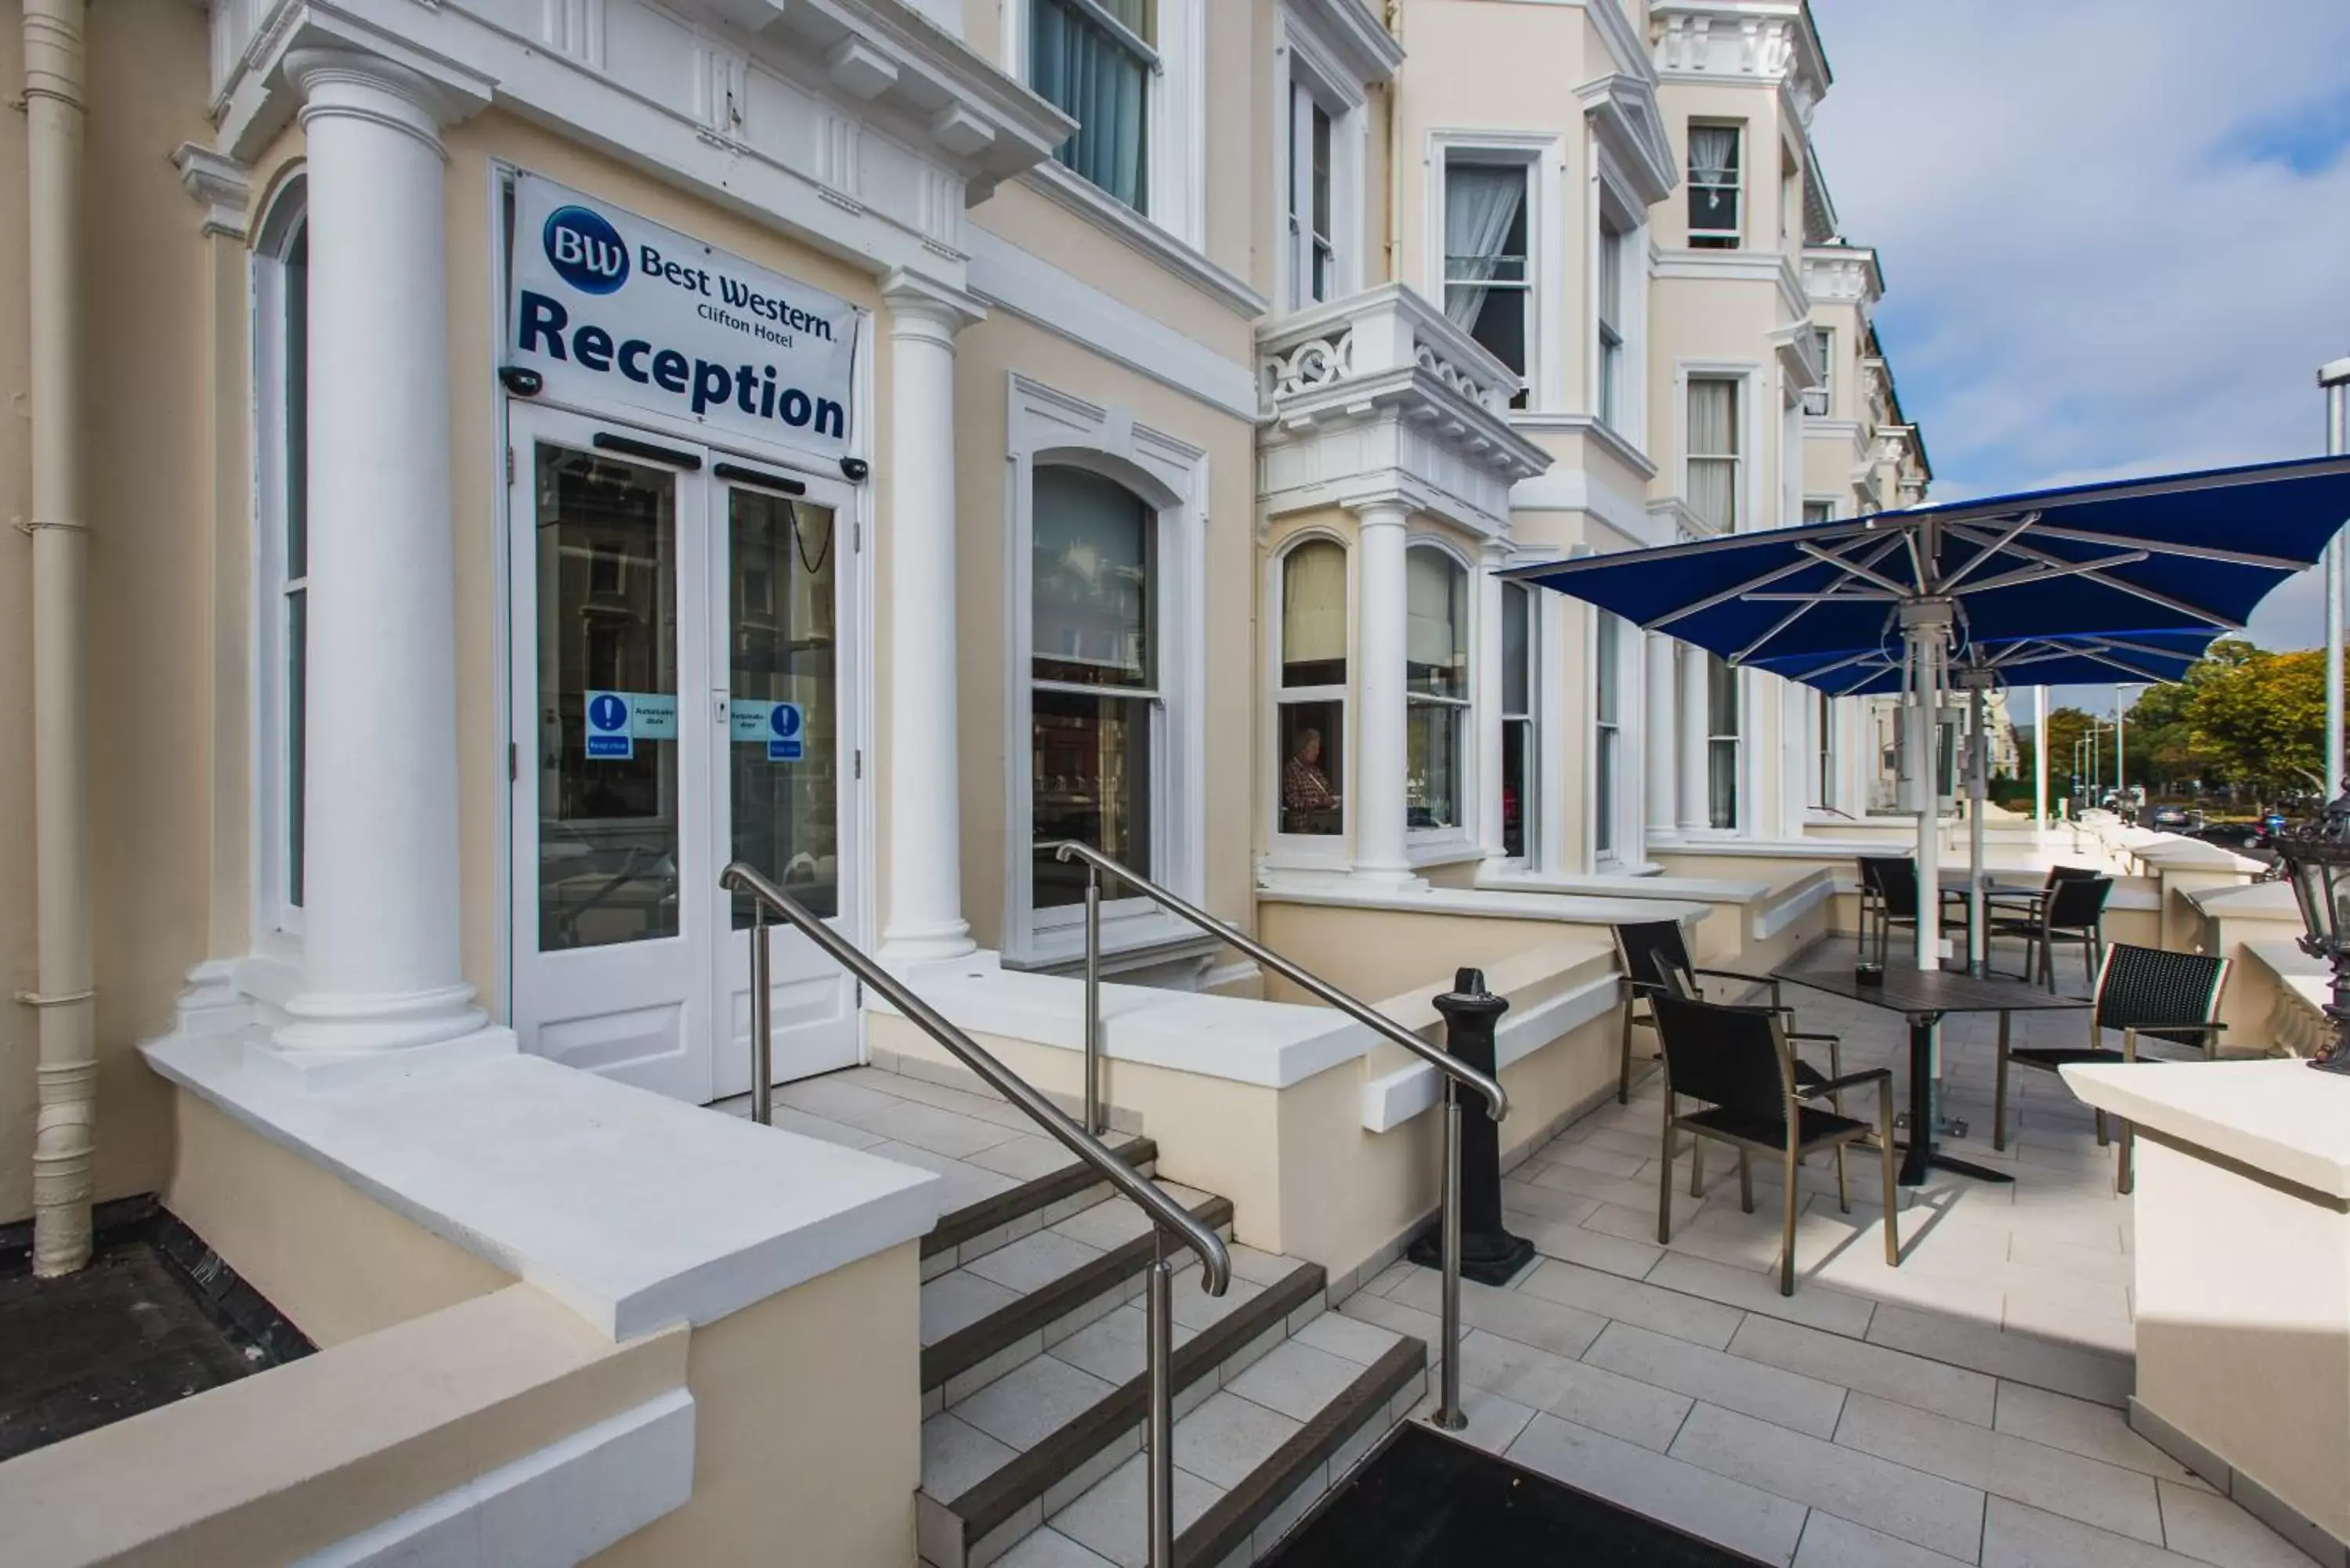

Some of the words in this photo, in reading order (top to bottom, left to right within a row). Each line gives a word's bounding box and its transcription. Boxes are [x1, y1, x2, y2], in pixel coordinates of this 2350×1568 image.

[554, 226, 623, 277] BW
[640, 244, 711, 297] Best
[719, 275, 832, 341] Western
[696, 303, 750, 334] Clifton
[754, 323, 794, 349] Hotel
[518, 289, 844, 439] Reception
